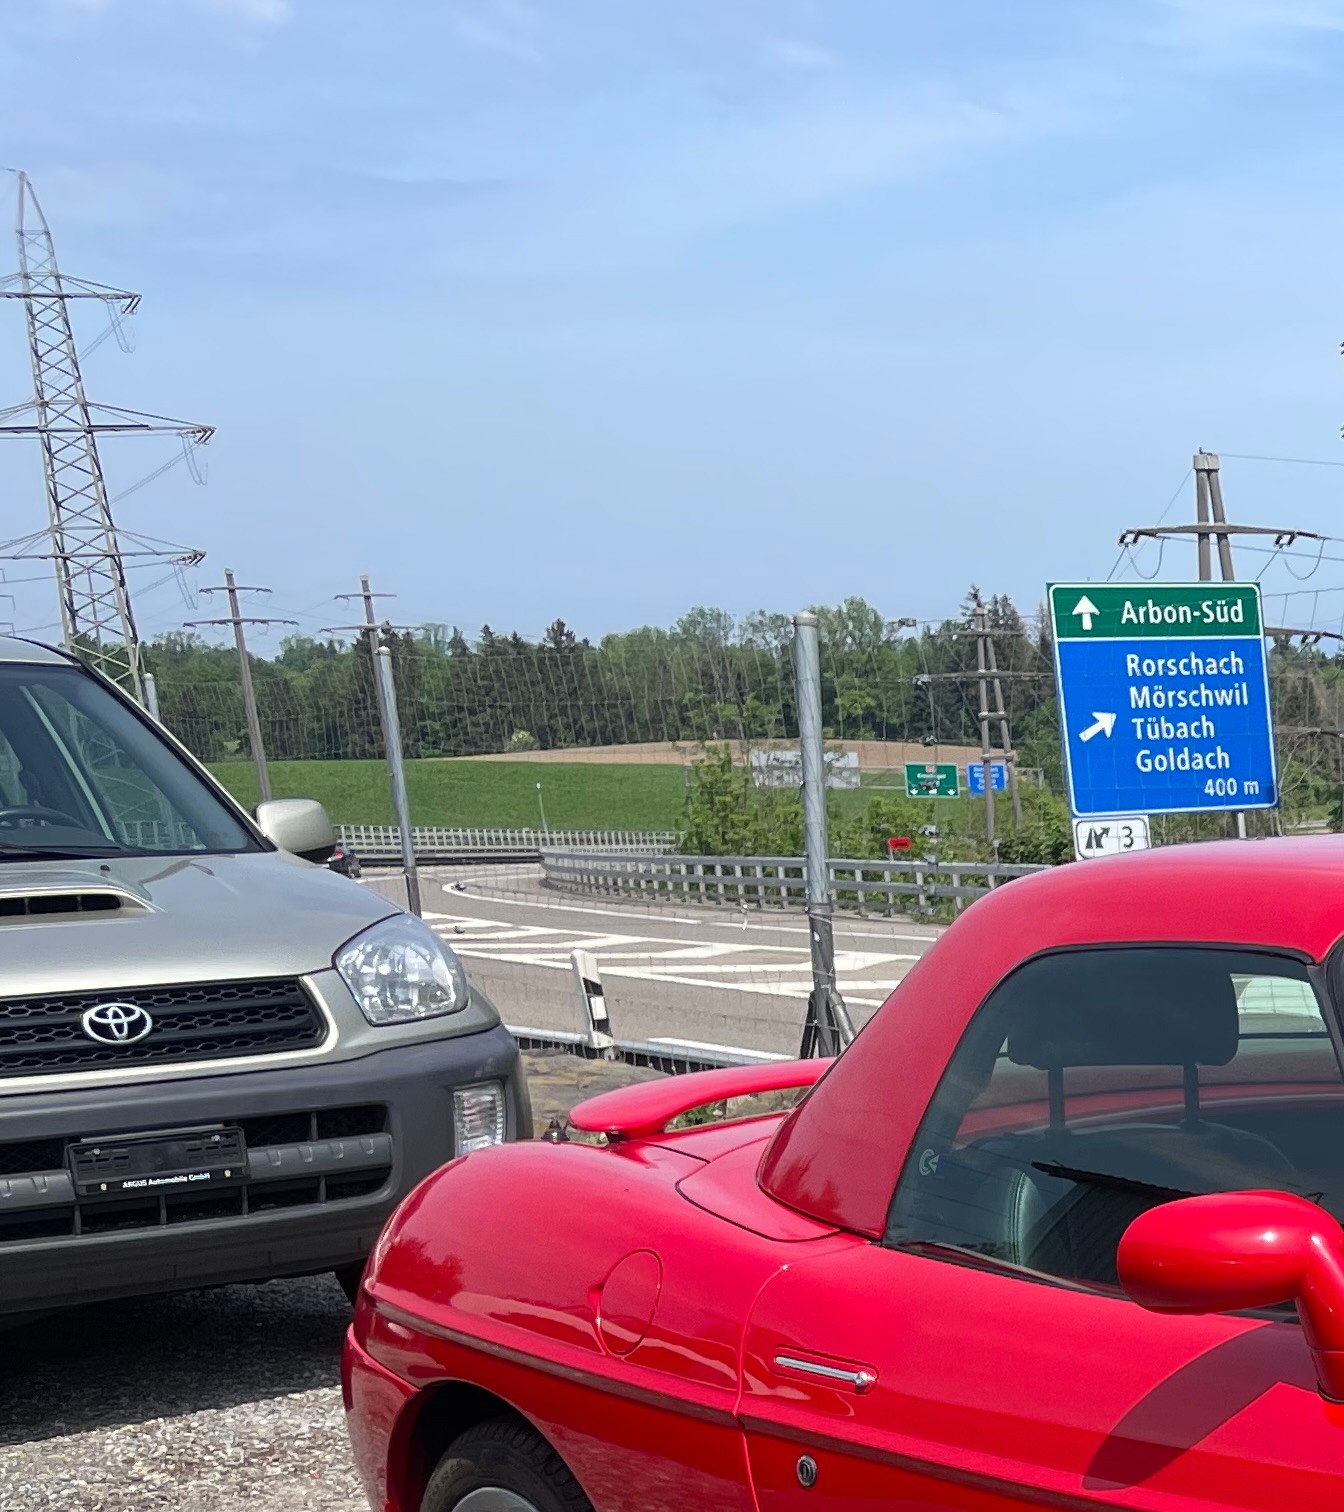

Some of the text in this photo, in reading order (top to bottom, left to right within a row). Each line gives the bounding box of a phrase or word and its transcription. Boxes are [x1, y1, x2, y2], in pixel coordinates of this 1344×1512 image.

[1121, 599, 1244, 625] Arbon-Süd
[1126, 651, 1244, 677] Rorschach
[1129, 682, 1249, 709] Mörschwil
[1131, 715, 1215, 740] Tübach
[1136, 746, 1230, 772] Goldach
[1204, 778, 1260, 797] 400 m
[1121, 825, 1134, 849] 3
